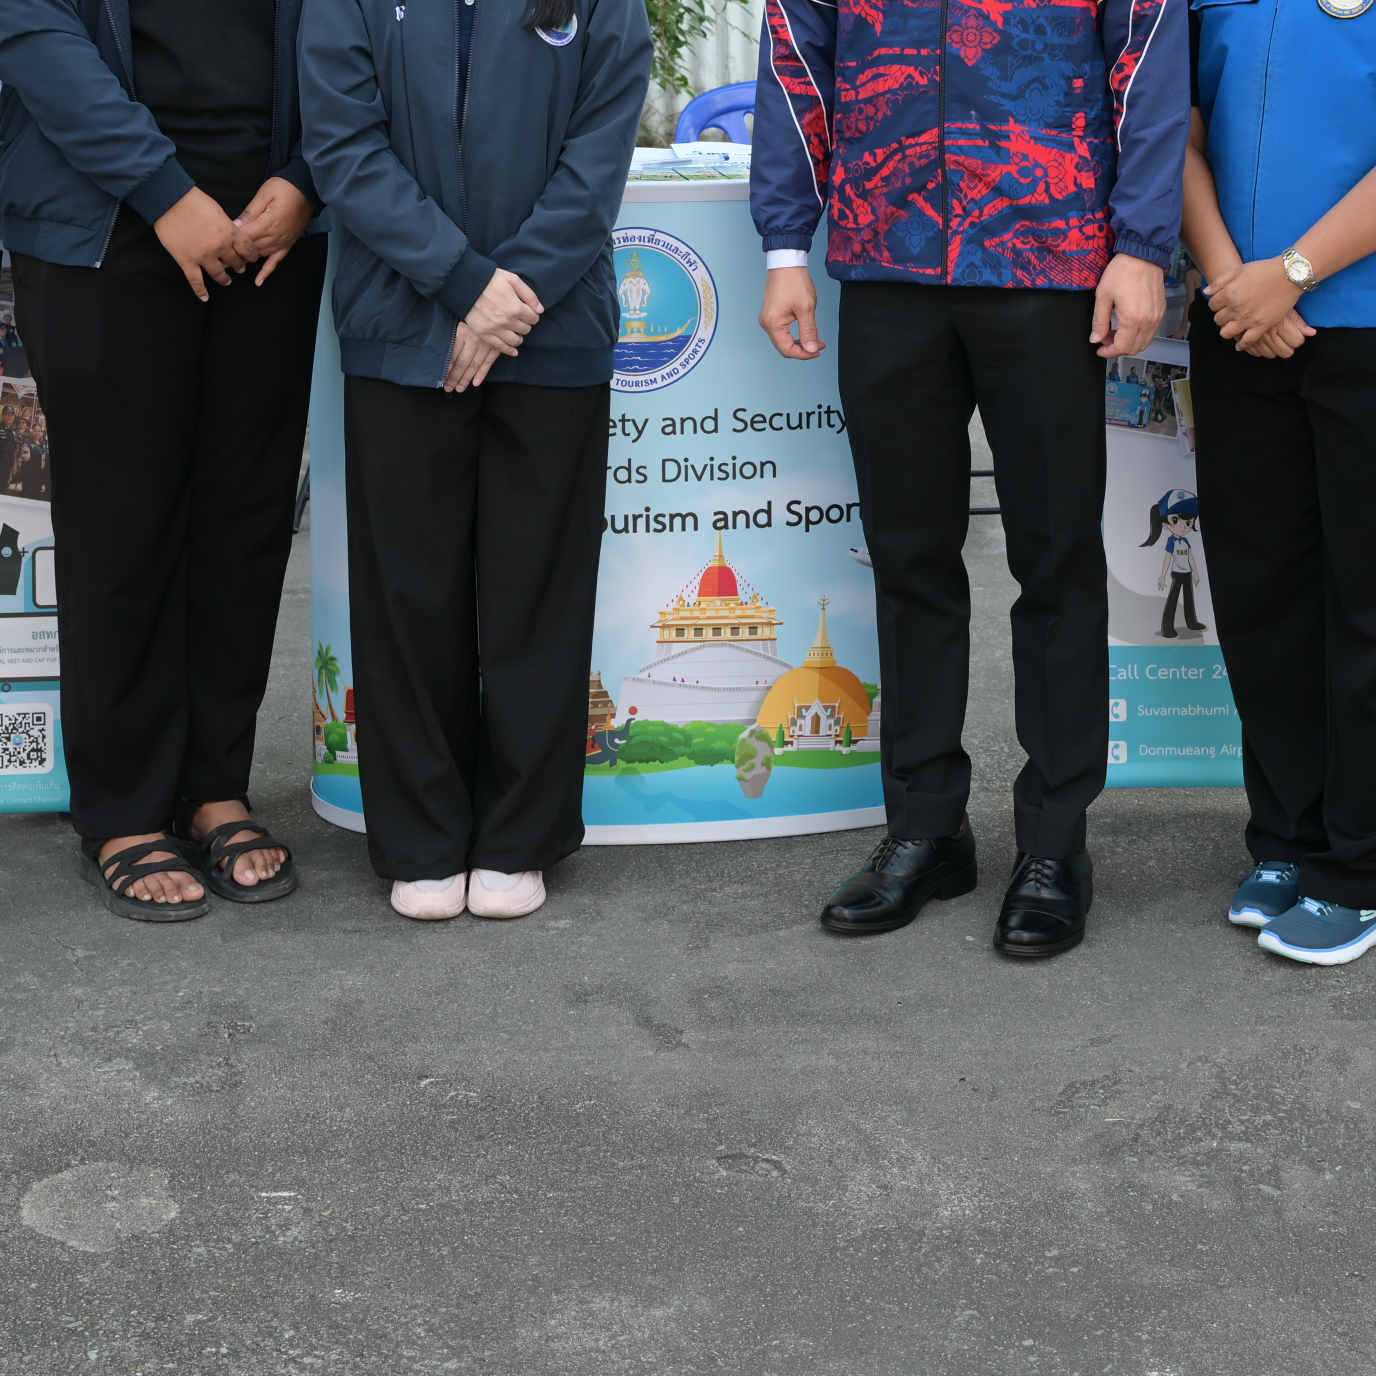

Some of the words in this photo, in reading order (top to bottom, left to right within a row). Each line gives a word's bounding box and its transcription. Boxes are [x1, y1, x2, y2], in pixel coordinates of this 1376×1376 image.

[615, 377, 658, 388] TOURISM
[661, 367, 680, 382] AND
[679, 337, 706, 370] SPORTS
[608, 412, 650, 444] ety
[660, 407, 719, 436] and
[731, 403, 847, 435] Security
[606, 457, 648, 484] rds
[661, 455, 777, 483] Division
[712, 500, 773, 531] and
[785, 499, 862, 533] Spor
[32, 630, 59, 640] อสทก
[1145, 664, 1206, 680] Center
[1137, 705, 1229, 717] Suvarnabhumi
[1139, 744, 1216, 759] Donmueang
[1220, 744, 1243, 758] Airp
[7, 796, 32, 804] Contact
[34, 795, 61, 803] Channel
